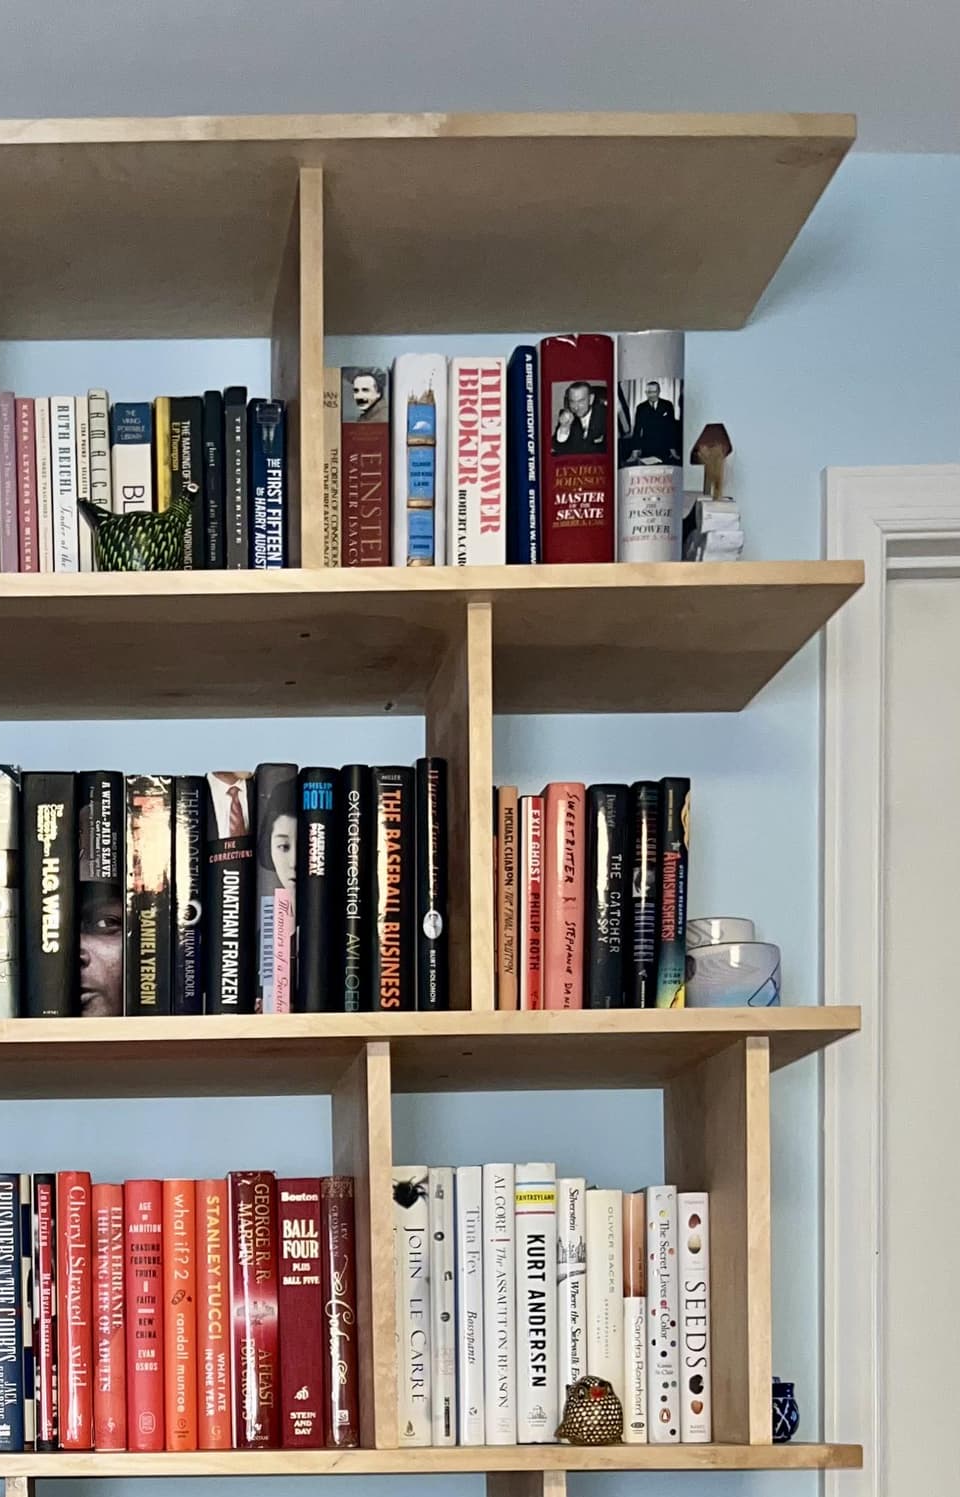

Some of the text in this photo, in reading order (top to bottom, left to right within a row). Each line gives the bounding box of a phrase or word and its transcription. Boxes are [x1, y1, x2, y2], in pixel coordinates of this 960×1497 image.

[57, 405, 71, 495] RUTH REICHL
[458, 367, 479, 485] BROKER
[480, 362, 502, 534] THE POWER
[554, 491, 605, 504] MASTER
[555, 508, 605, 520] SENATE
[346, 790, 361, 919] extraterrestrial
[43, 894, 59, 953] WELLS
[140, 910, 155, 1005] DANIEL YERGIN
[222, 869, 239, 1004] JONATHAN FRANZEN
[173, 1194, 189, 1279] what if? 2
[206, 1195, 222, 1340] STANLEY TUCCI
[526, 1235, 546, 1387] KURT ANDERSEN
[685, 1281, 707, 1369] SEEDS
[177, 1312, 189, 1413] randall munroe
